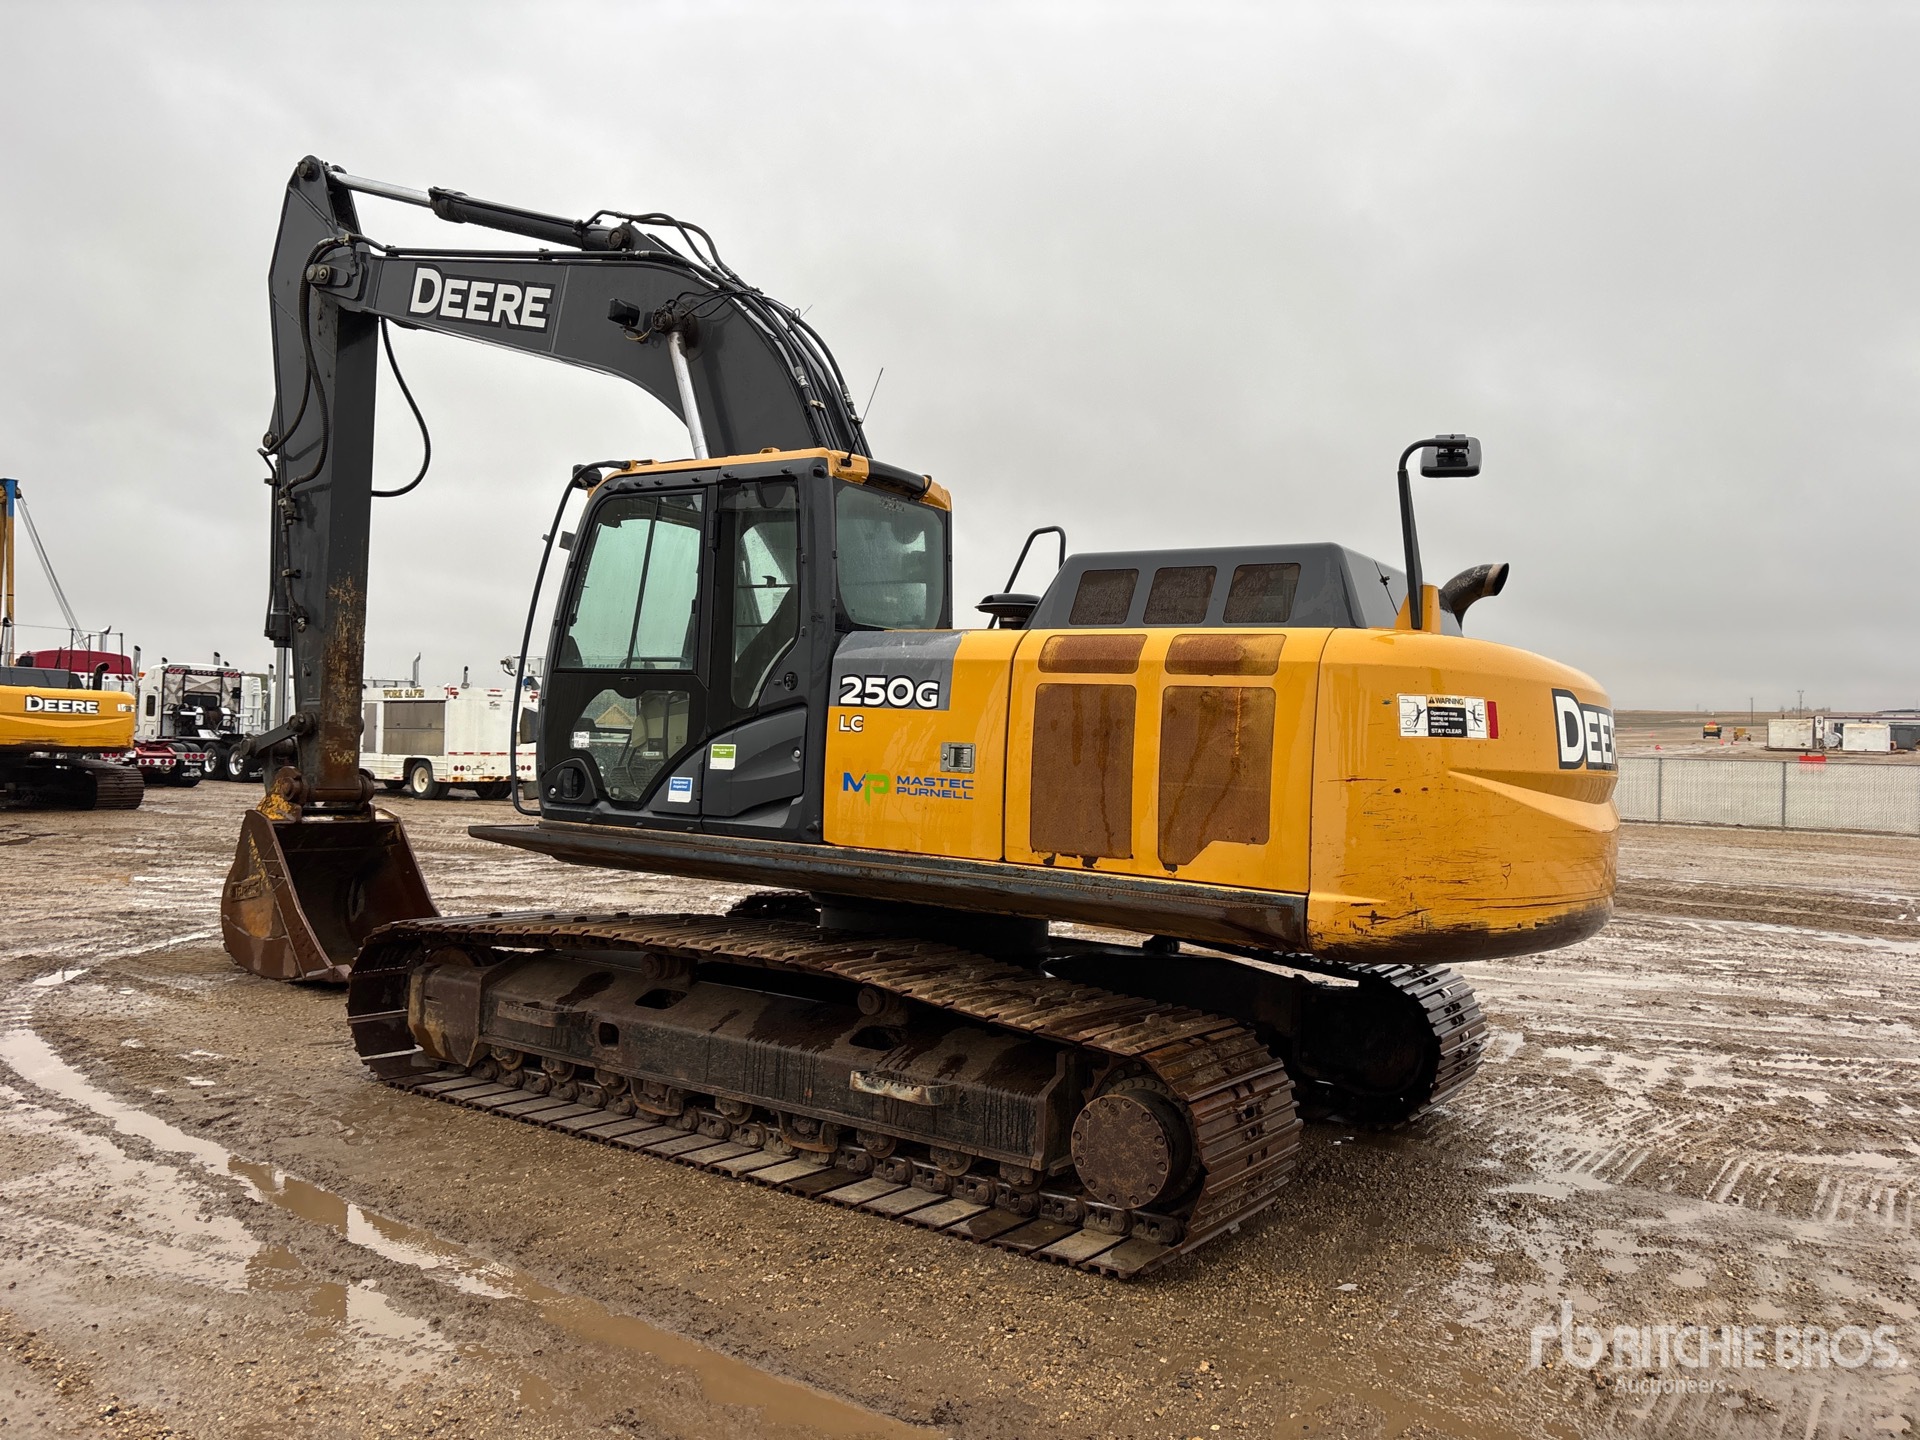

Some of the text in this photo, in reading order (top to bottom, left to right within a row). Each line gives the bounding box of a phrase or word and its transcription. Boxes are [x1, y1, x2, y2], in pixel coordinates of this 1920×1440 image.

[409, 266, 553, 329] DEERE
[383, 689, 403, 699] WORK
[839, 675, 939, 708] 250G
[25, 695, 99, 714] DEERE
[1434, 697, 1464, 706] WARNING
[839, 715, 864, 732] LC
[896, 775, 974, 789] MASTEC
[896, 786, 974, 800] PURNELL
